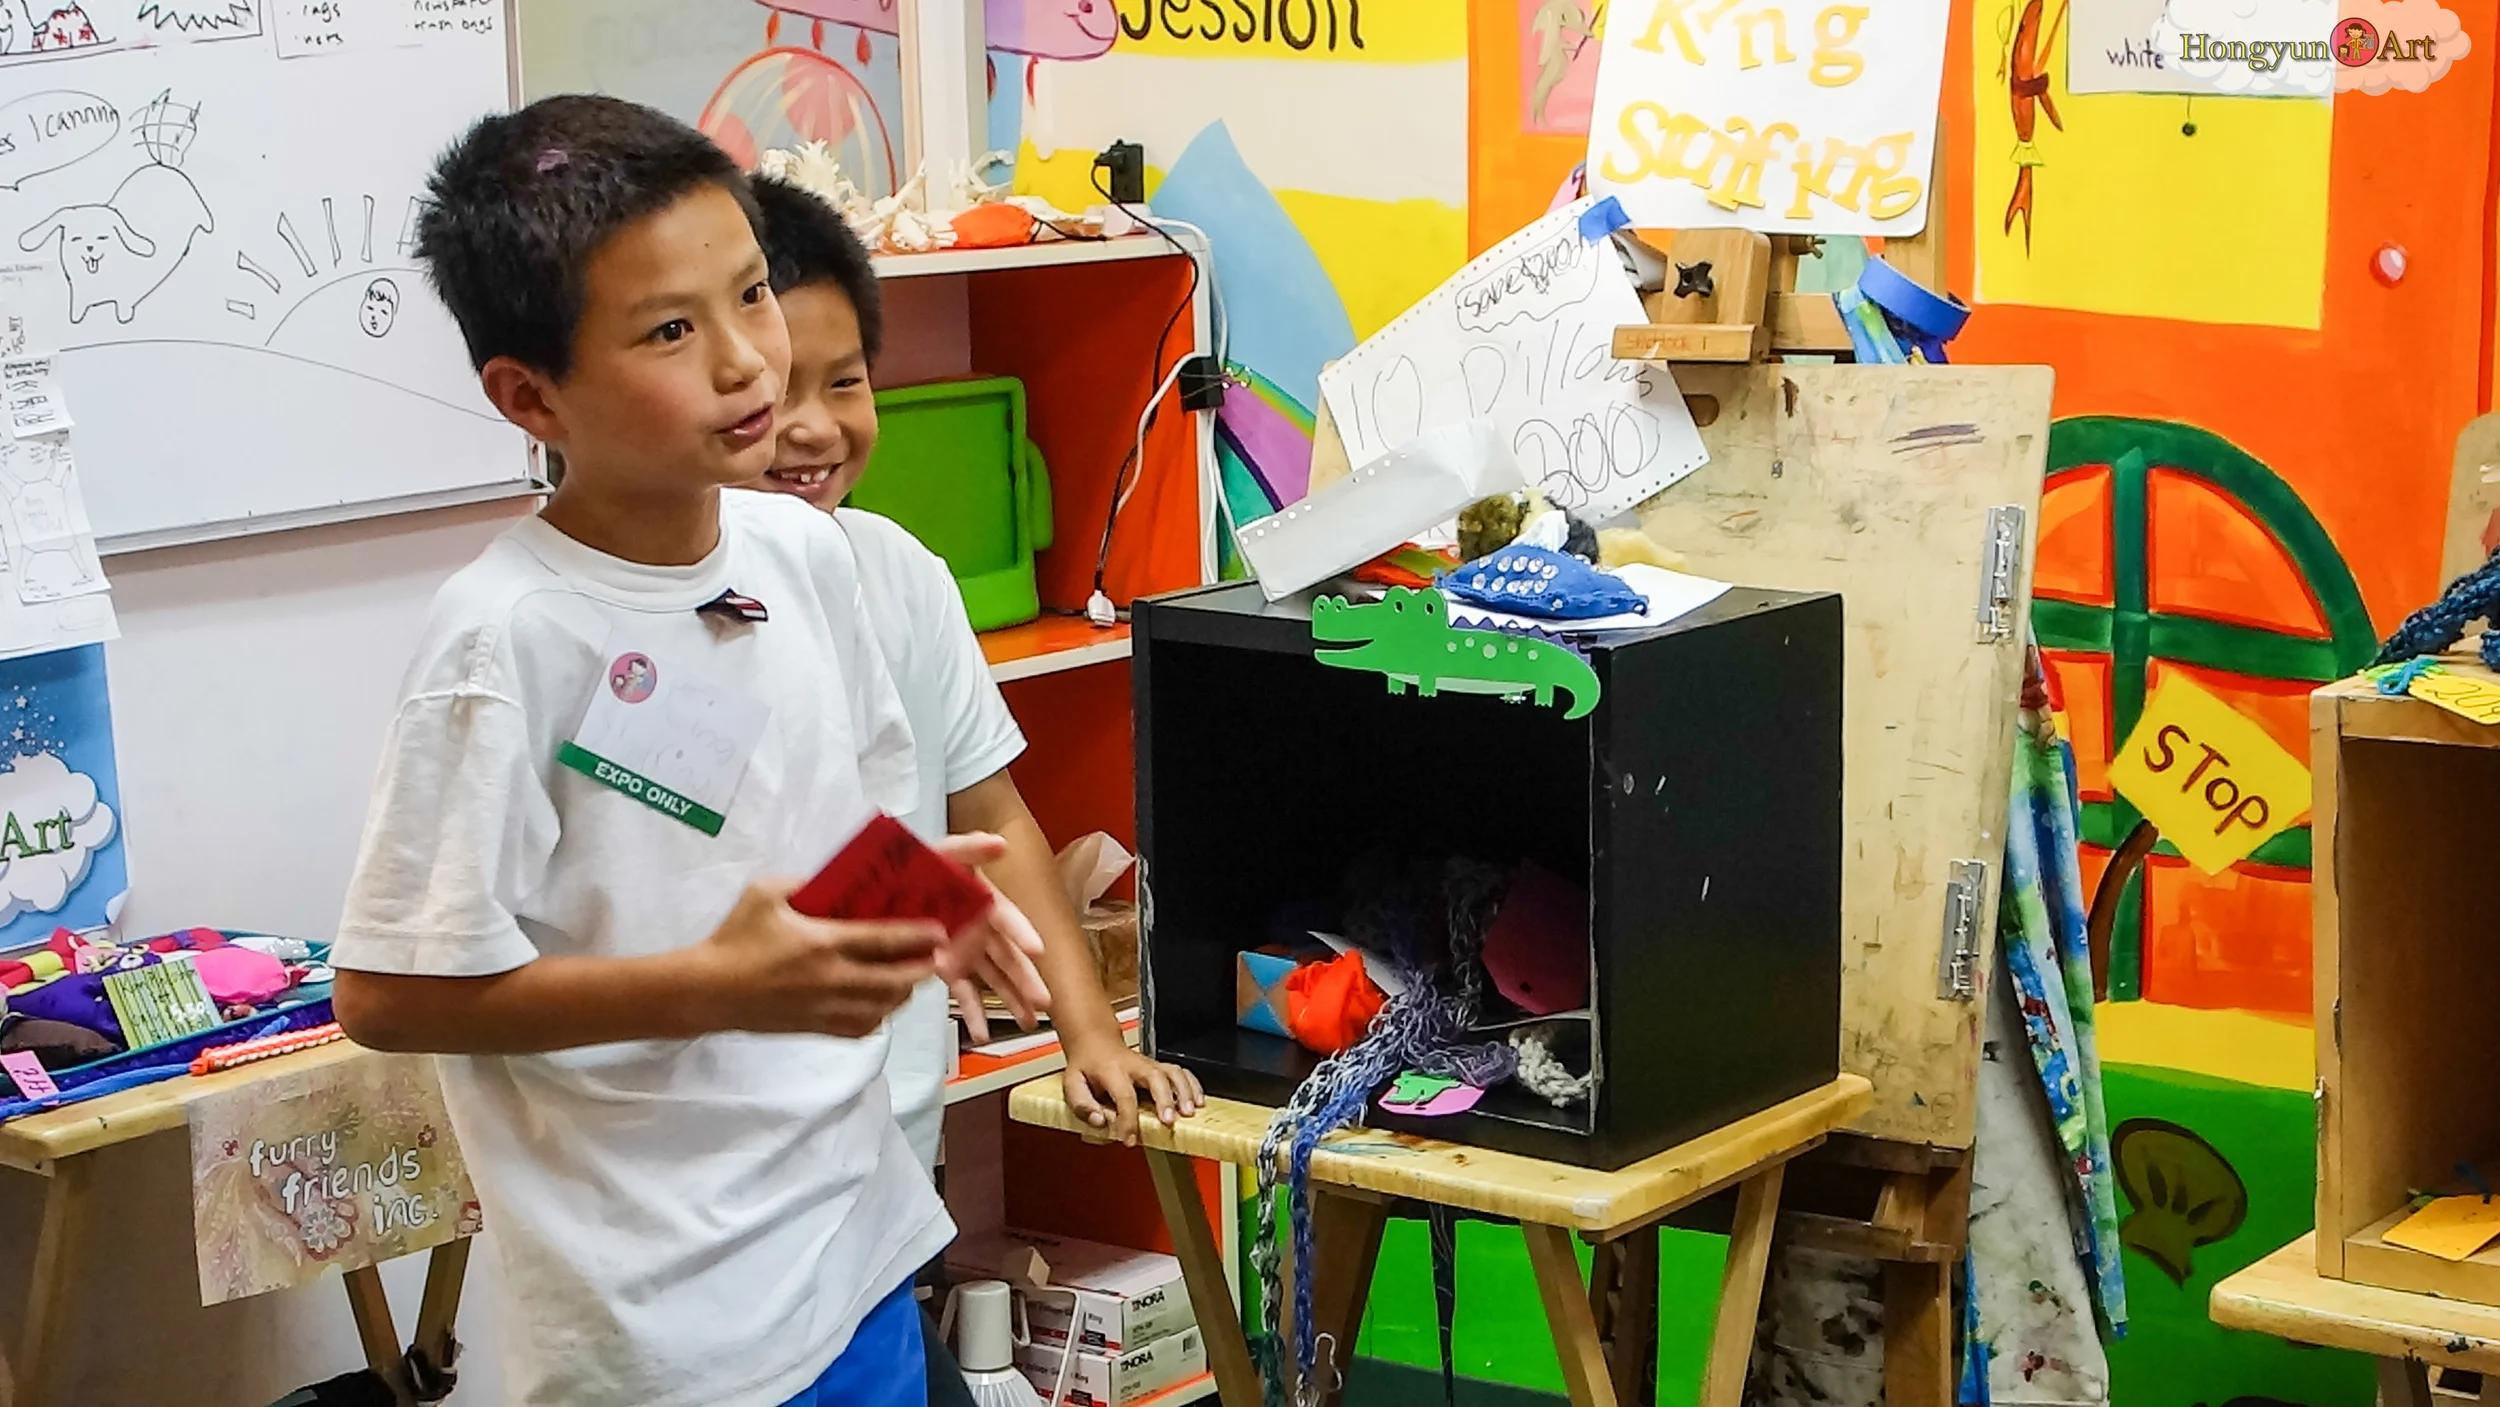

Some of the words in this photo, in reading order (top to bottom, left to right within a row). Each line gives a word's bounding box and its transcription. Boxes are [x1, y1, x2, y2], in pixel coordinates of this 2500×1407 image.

[2105, 37, 2164, 69] white
[594, 760, 643, 795] EXPO
[645, 785, 693, 817] ONLY
[0, 806, 76, 862] Art
[250, 1130, 337, 1177] furry
[281, 1145, 422, 1215] friends
[372, 1194, 440, 1236] inc.
